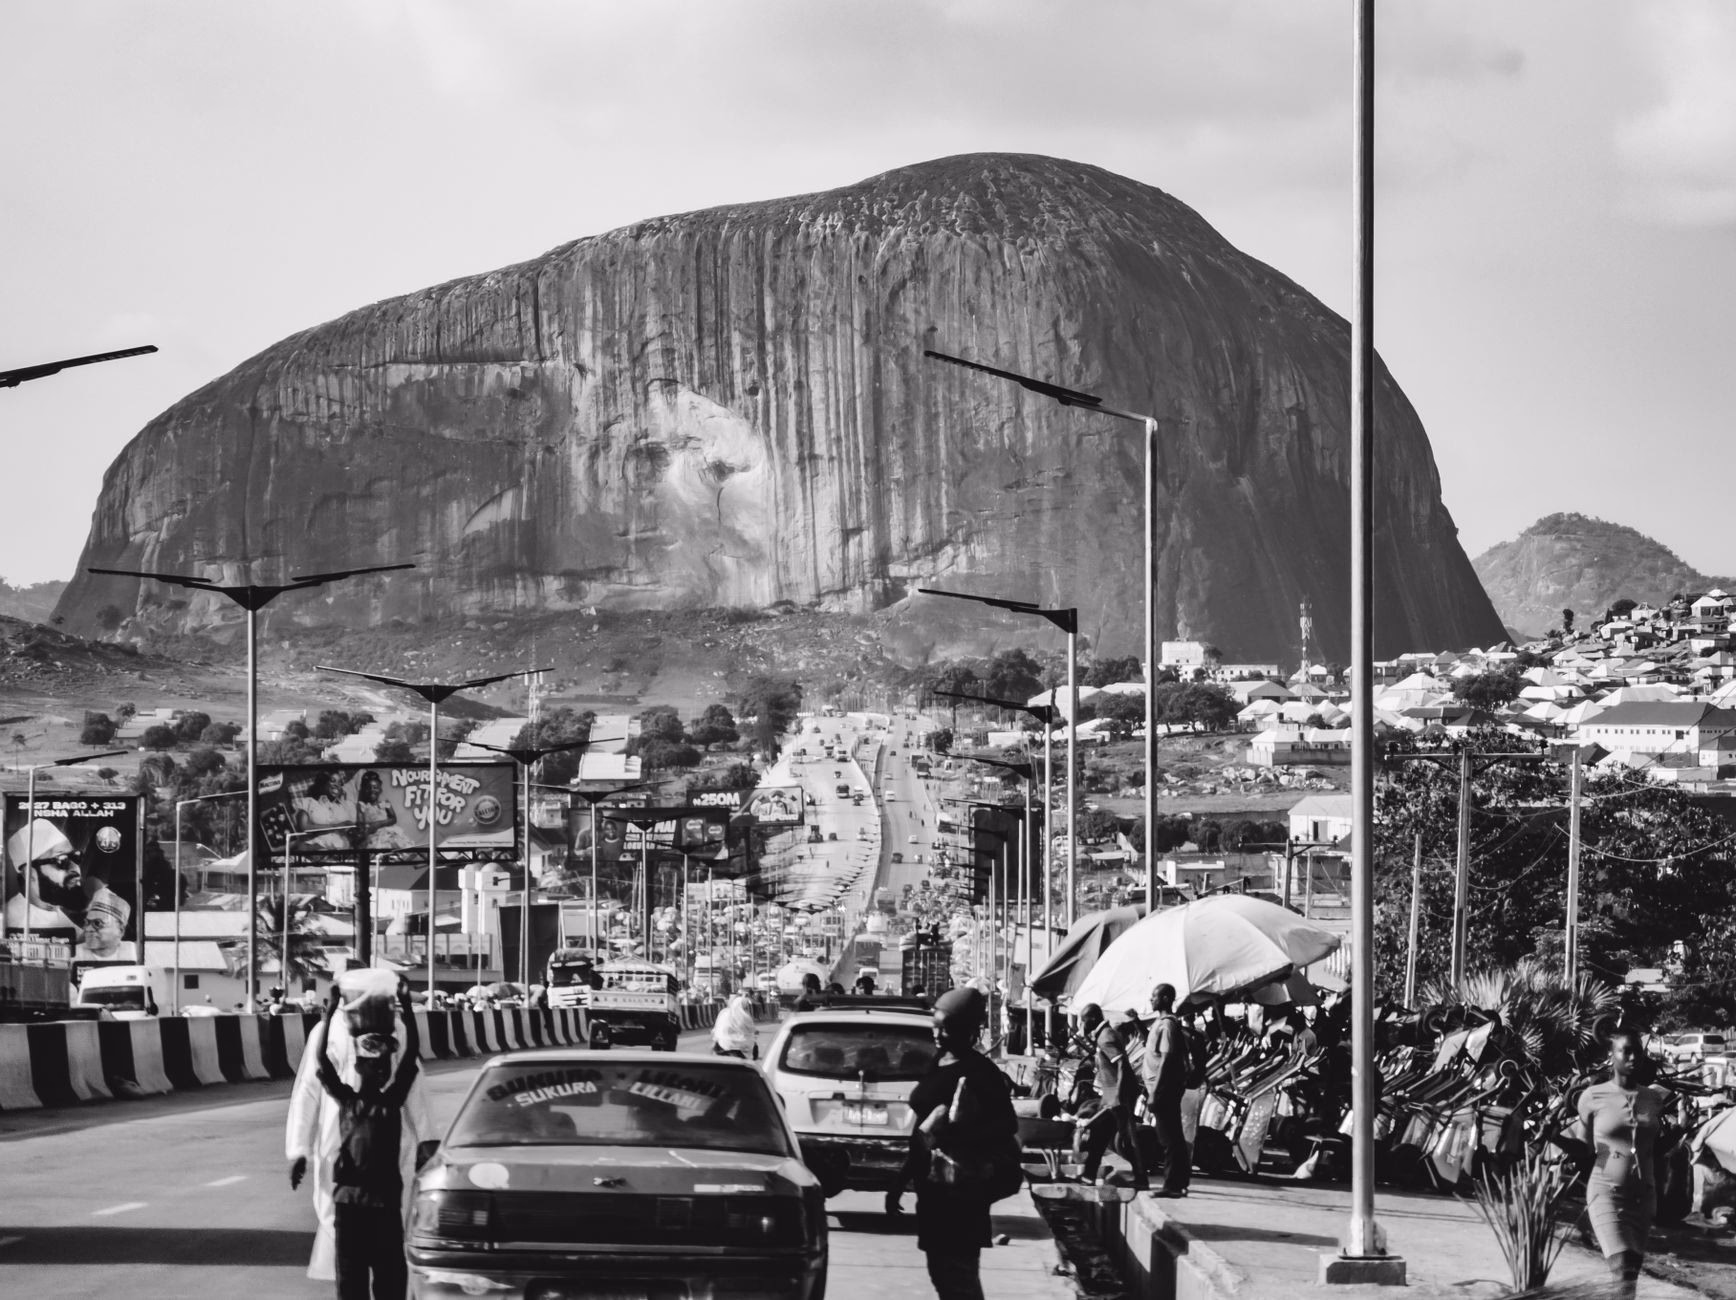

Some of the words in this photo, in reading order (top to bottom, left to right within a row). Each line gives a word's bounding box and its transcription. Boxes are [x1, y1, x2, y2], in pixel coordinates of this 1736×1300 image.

[391, 768, 480, 794] NOURHMENT
[102, 802, 126, 810] 313
[404, 784, 431, 808] FIT
[435, 787, 466, 813] FOR
[32, 810, 69, 818] NSHA
[515, 1081, 598, 1107] SUKURA
